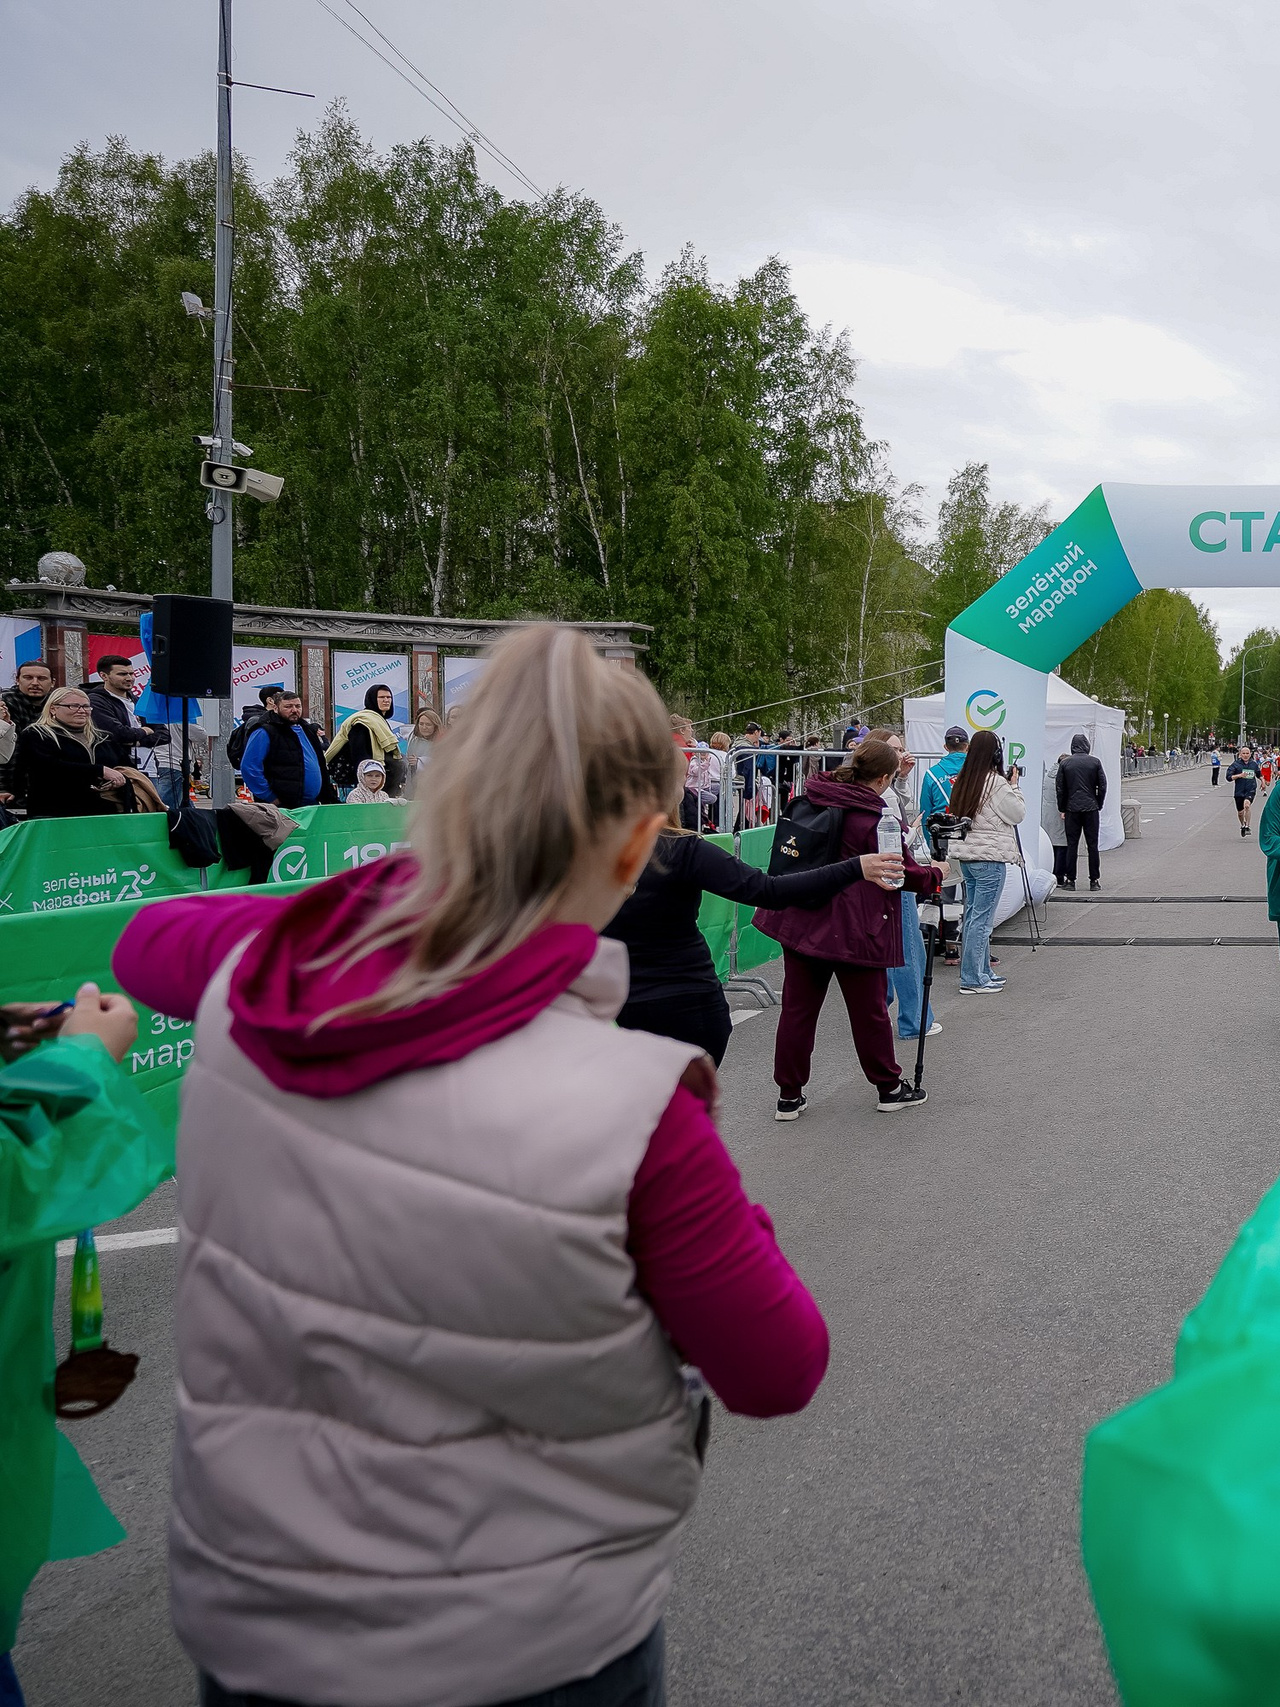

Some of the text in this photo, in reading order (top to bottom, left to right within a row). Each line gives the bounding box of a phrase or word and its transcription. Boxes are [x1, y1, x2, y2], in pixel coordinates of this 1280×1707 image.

[1005, 541, 1085, 619] зелёный
[1018, 559, 1098, 634] марафон
[232, 658, 259, 674] ЫТЬ
[232, 656, 289, 687] РОССИЕЙ
[345, 660, 378, 679] БЫТЬ
[349, 659, 402, 689] ДВИЖЕНИИ
[42, 868, 117, 893] зелёный
[32, 889, 111, 912] марафон
